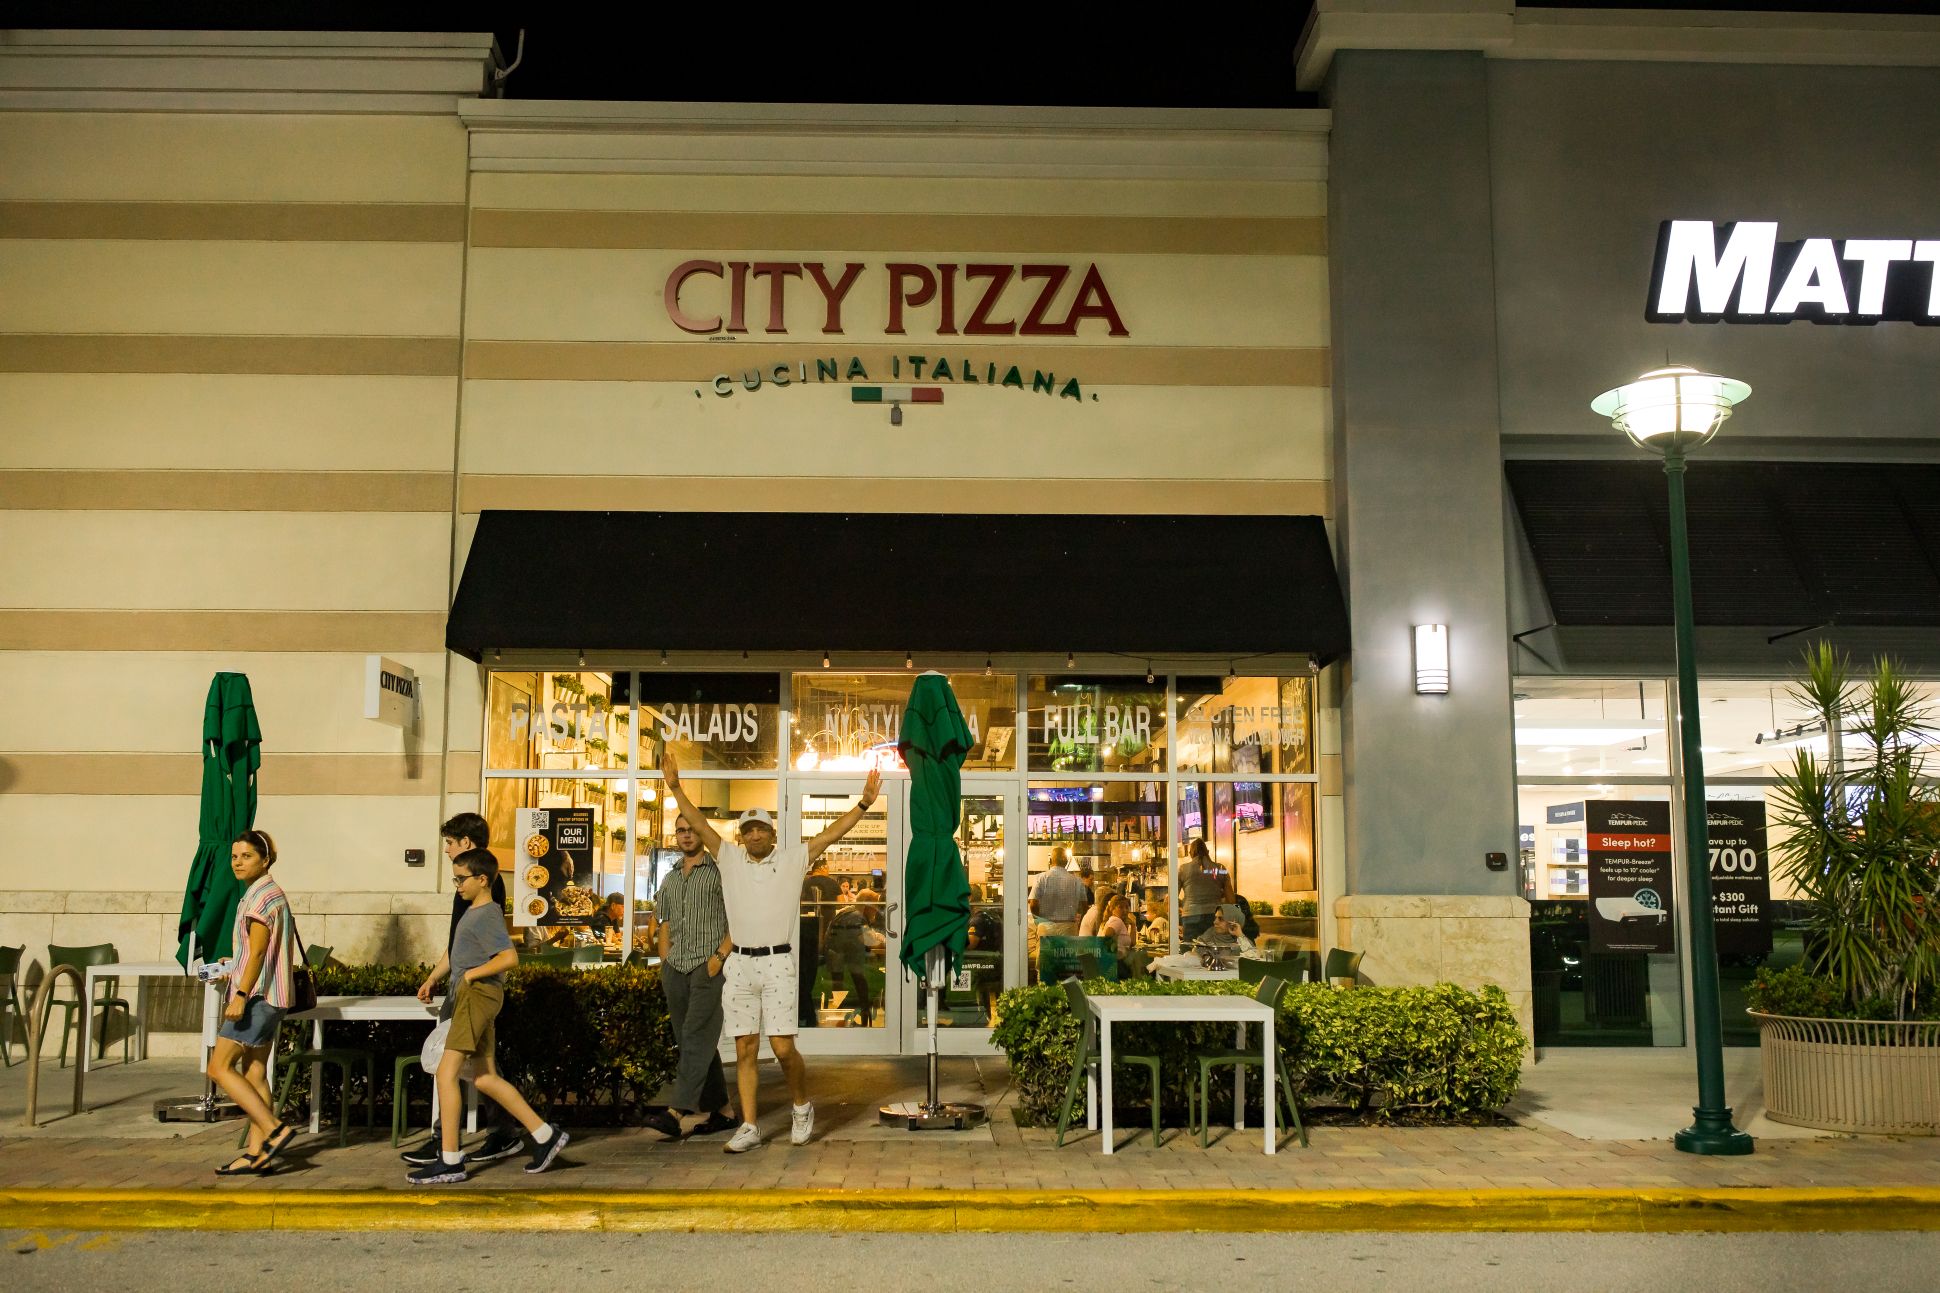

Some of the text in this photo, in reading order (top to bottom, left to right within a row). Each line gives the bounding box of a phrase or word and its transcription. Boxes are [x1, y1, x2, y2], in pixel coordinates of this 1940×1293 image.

[664, 259, 1130, 336] CITY PIZZA
[711, 355, 1082, 401] CUCINA ITALIANA
[380, 670, 395, 691] CITY
[510, 703, 608, 741] PASTA
[660, 702, 758, 742] SALADS
[825, 704, 850, 743] NY
[1043, 705, 1151, 744] FULL BAR
[1188, 706, 1304, 723] GLUTEN FREE
[1188, 728, 1222, 745] VEGAN
[1224, 729, 1231, 744] &
[563, 828, 582, 836] OUR
[1602, 838, 1656, 849] Sleep hot?
[1708, 848, 1757, 872] 700
[1720, 892, 1745, 902] $300
[1738, 904, 1758, 914] Gift
